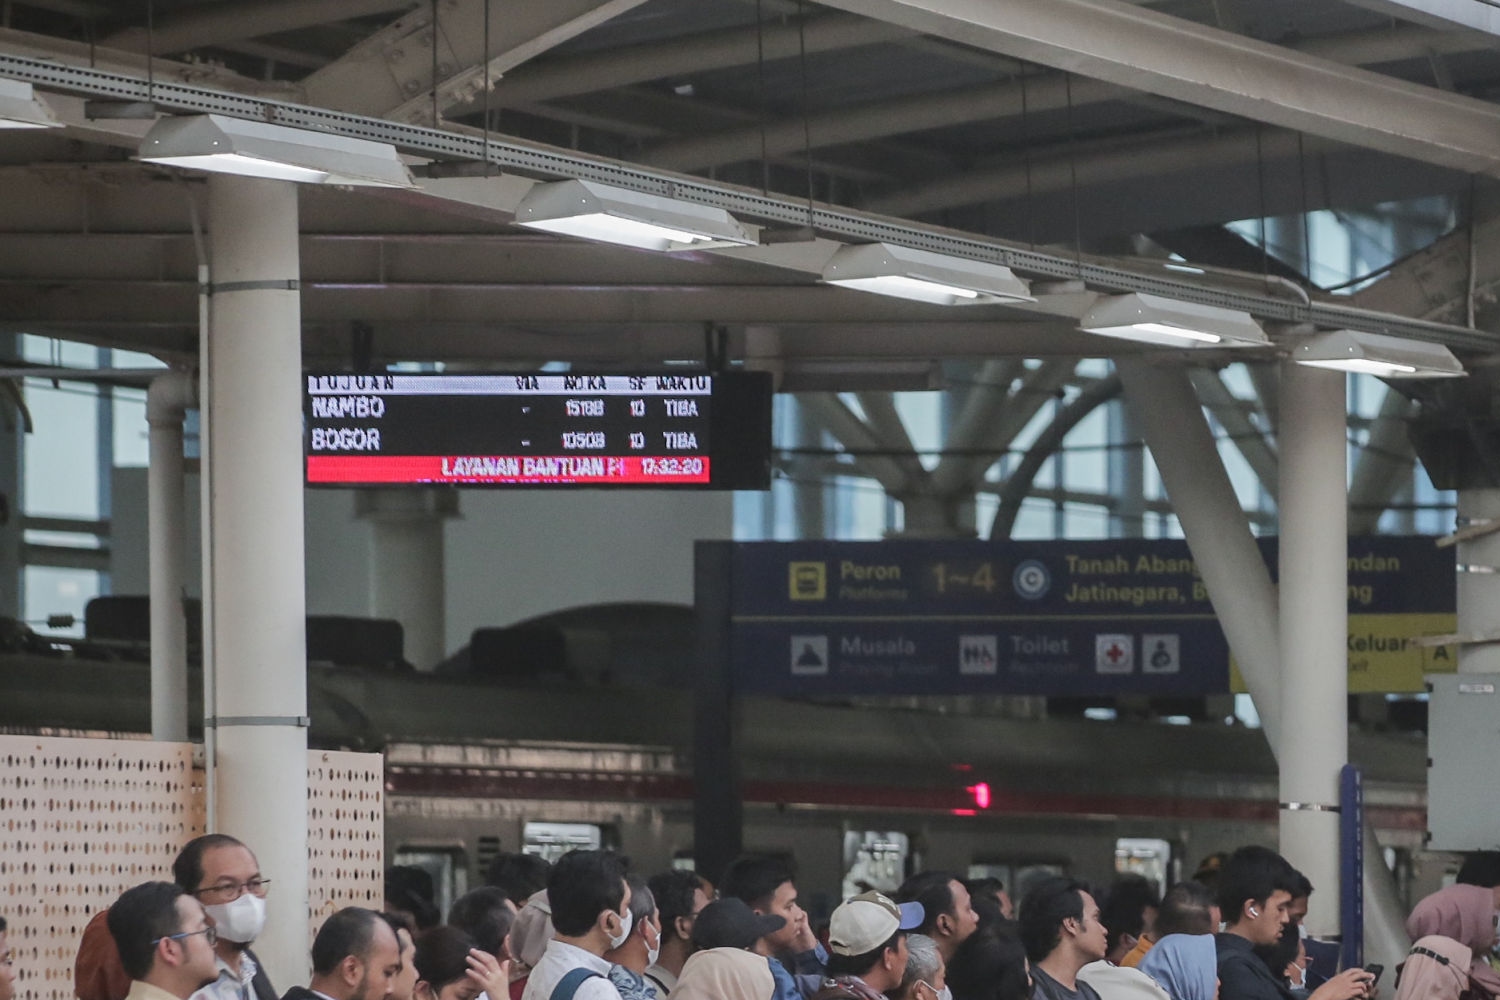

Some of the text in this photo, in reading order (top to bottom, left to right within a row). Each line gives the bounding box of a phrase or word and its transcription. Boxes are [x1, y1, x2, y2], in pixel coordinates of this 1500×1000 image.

[311, 396, 385, 418] NAMBO
[664, 399, 699, 416] TIBA
[311, 428, 382, 451] BOGOR
[663, 432, 698, 449] TIBA
[441, 457, 519, 476] LAYANAN
[523, 456, 605, 476] BANTUAN
[840, 561, 901, 581] Peron
[1065, 555, 1129, 574] Tanah
[1347, 552, 1400, 571] ndan
[1065, 583, 1186, 606] Jatinegara,
[1347, 586, 1373, 605] ng
[840, 636, 917, 655] Musala
[1010, 635, 1070, 655] Toilet
